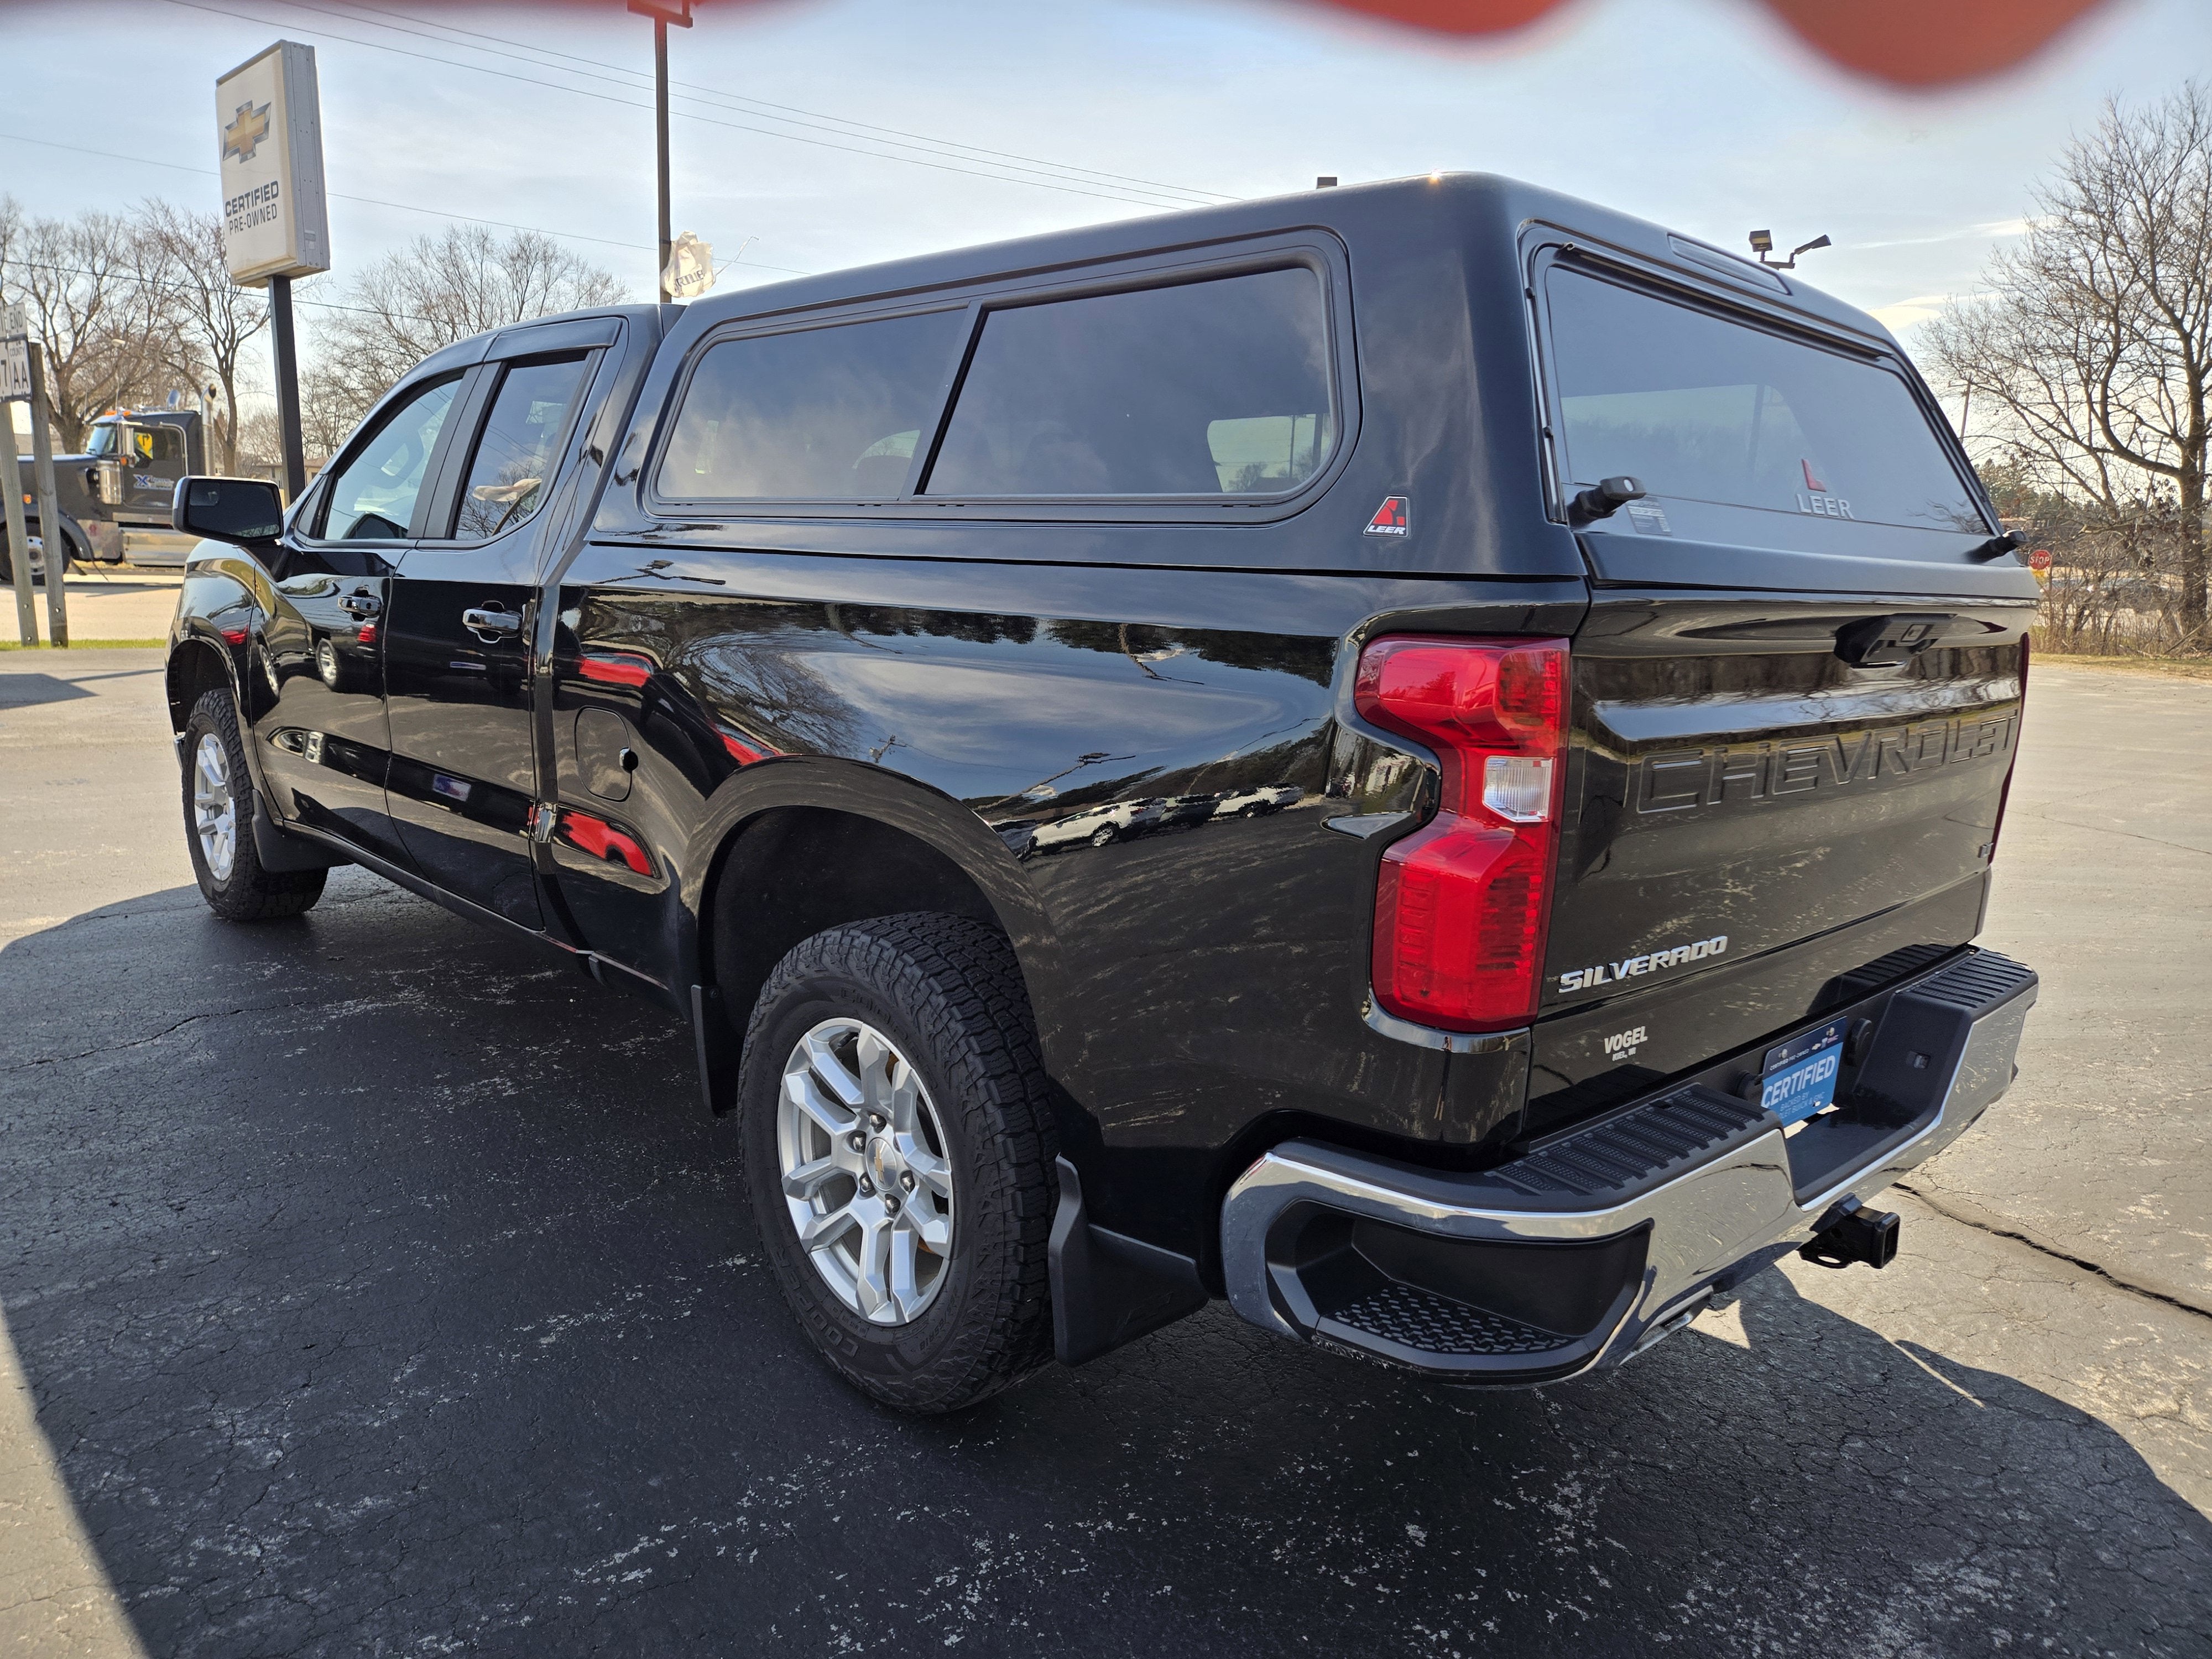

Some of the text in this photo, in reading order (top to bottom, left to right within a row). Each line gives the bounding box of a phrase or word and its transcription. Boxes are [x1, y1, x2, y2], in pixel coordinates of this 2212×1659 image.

[225, 181, 279, 217] CERTIFIED
[229, 204, 277, 235] PRE-OWNED
[9, 311, 23, 330] END
[9, 346, 25, 357] COUNTY
[13, 361, 29, 389] AA
[1795, 493, 1854, 520] LEER
[1367, 525, 1406, 535] LEER
[2030, 556, 2049, 564] STOP
[1636, 709, 2017, 814] CHEVROLET
[1558, 935, 1728, 994] SILVERADO
[1604, 1026, 1648, 1054] VOGEL
[1760, 1055, 1836, 1108] CERTIFIED
[1802, 1091, 1809, 1100] BY
